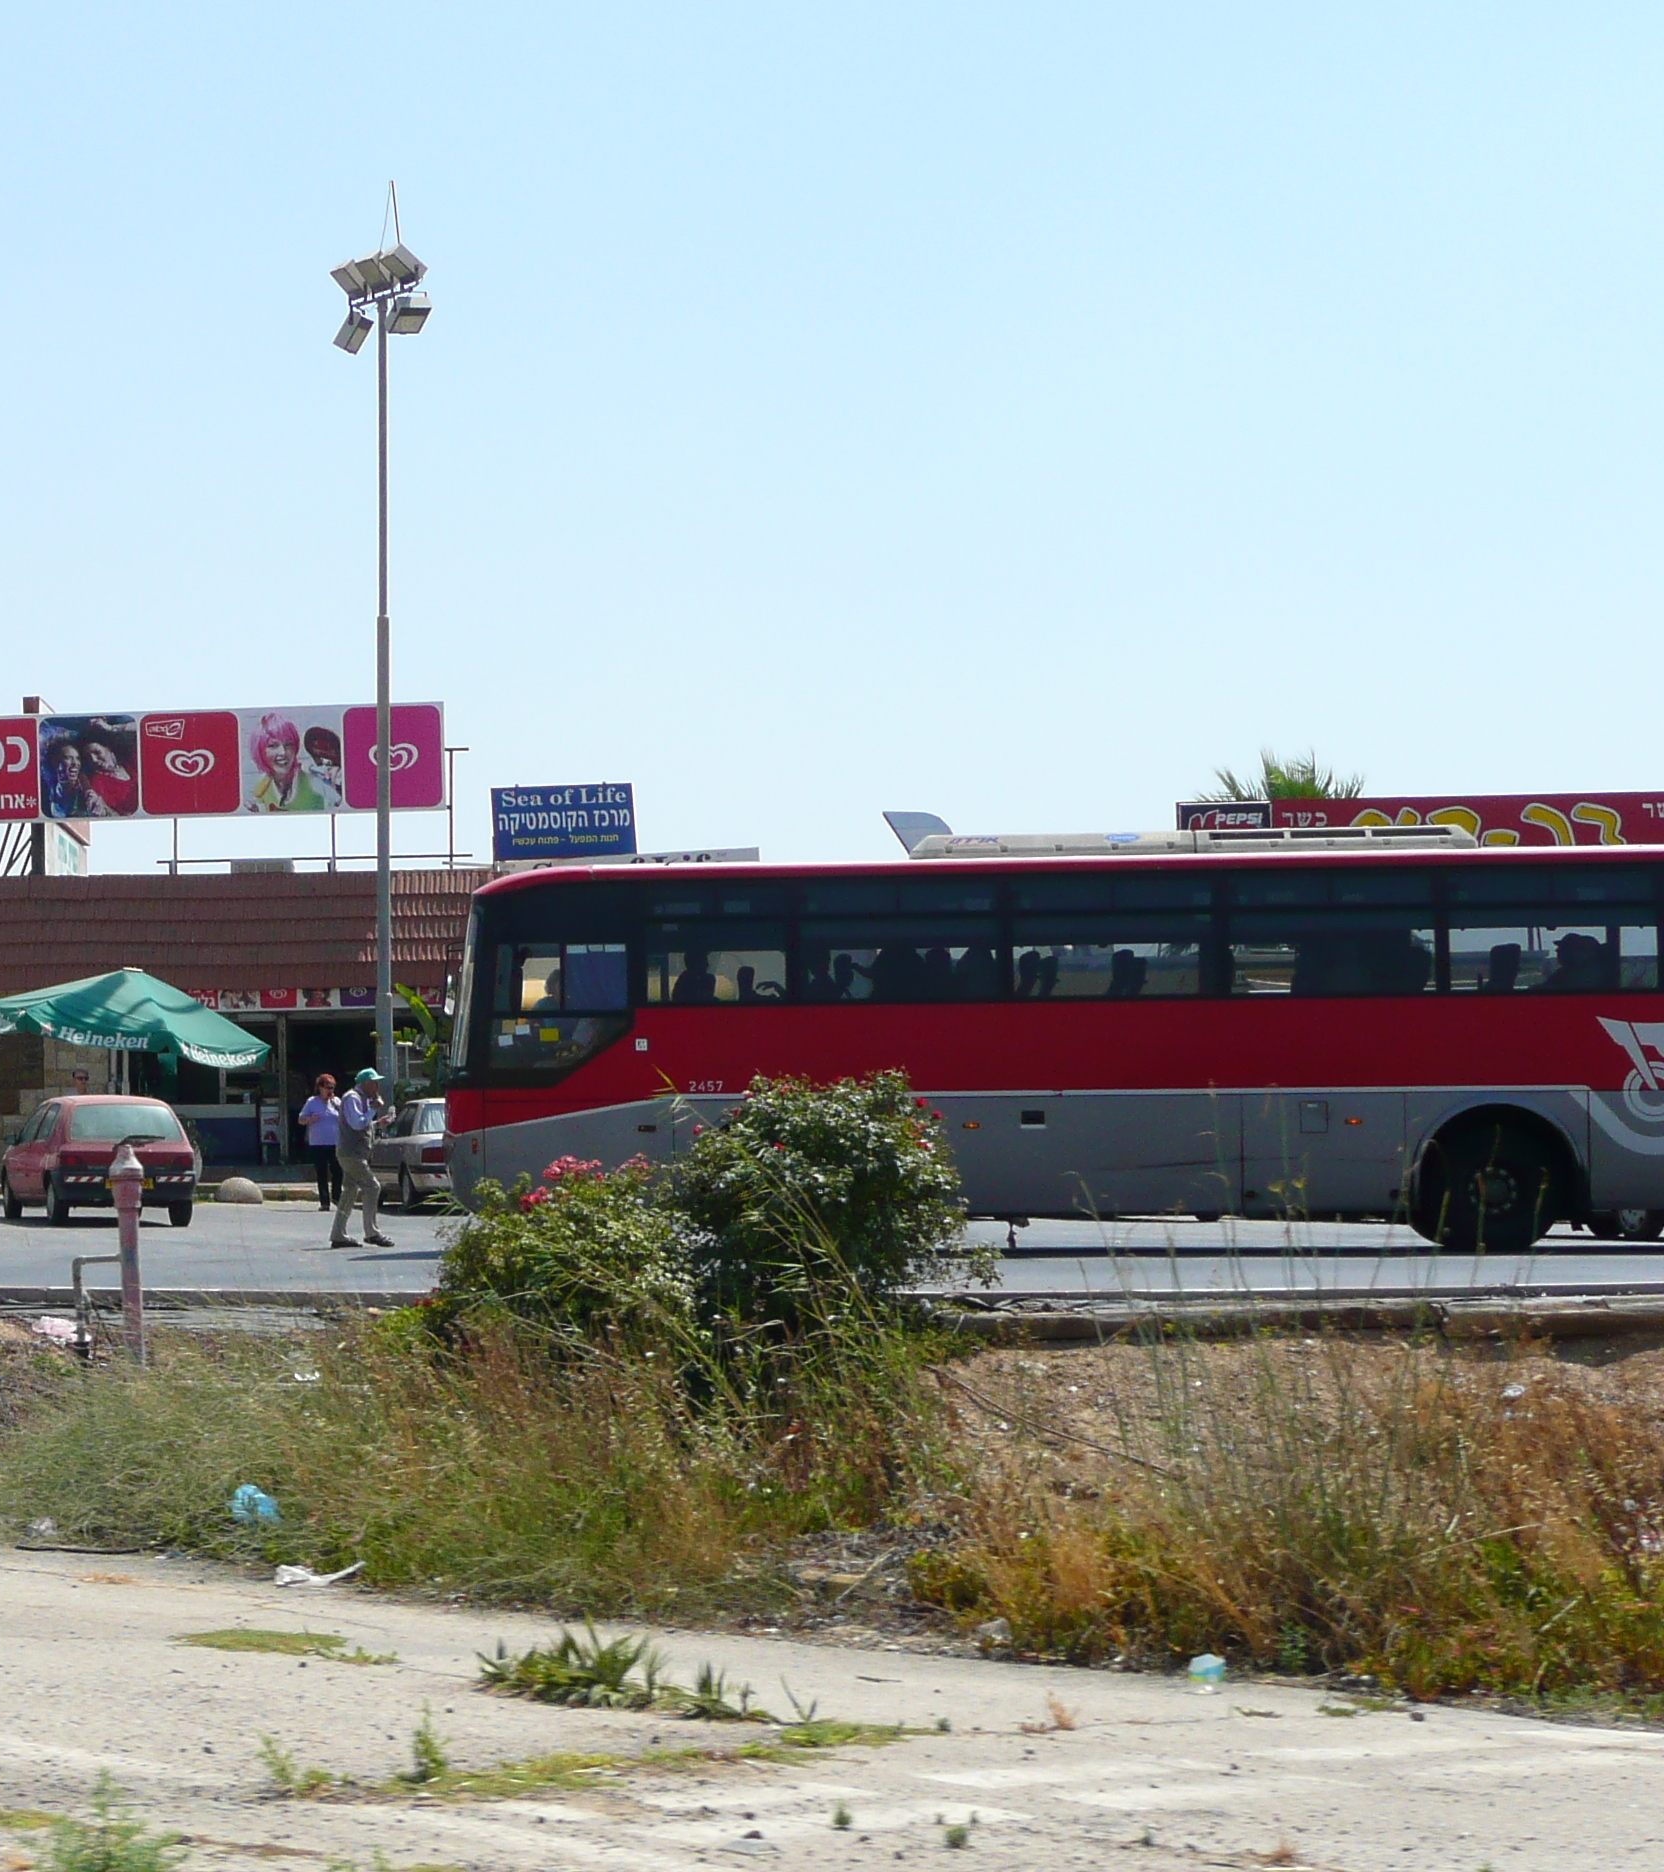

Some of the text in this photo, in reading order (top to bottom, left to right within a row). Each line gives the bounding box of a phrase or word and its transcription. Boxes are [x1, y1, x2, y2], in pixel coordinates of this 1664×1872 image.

[501, 786, 628, 808] Sea of Life
[497, 808, 631, 835] מרכז הקוסמטיקה
[1214, 812, 1263, 825] PEPSI
[1281, 811, 1328, 828] כשר
[57, 1025, 150, 1050] Heineken
[190, 1044, 257, 1068] Heineken
[688, 1080, 724, 1092] 2457
